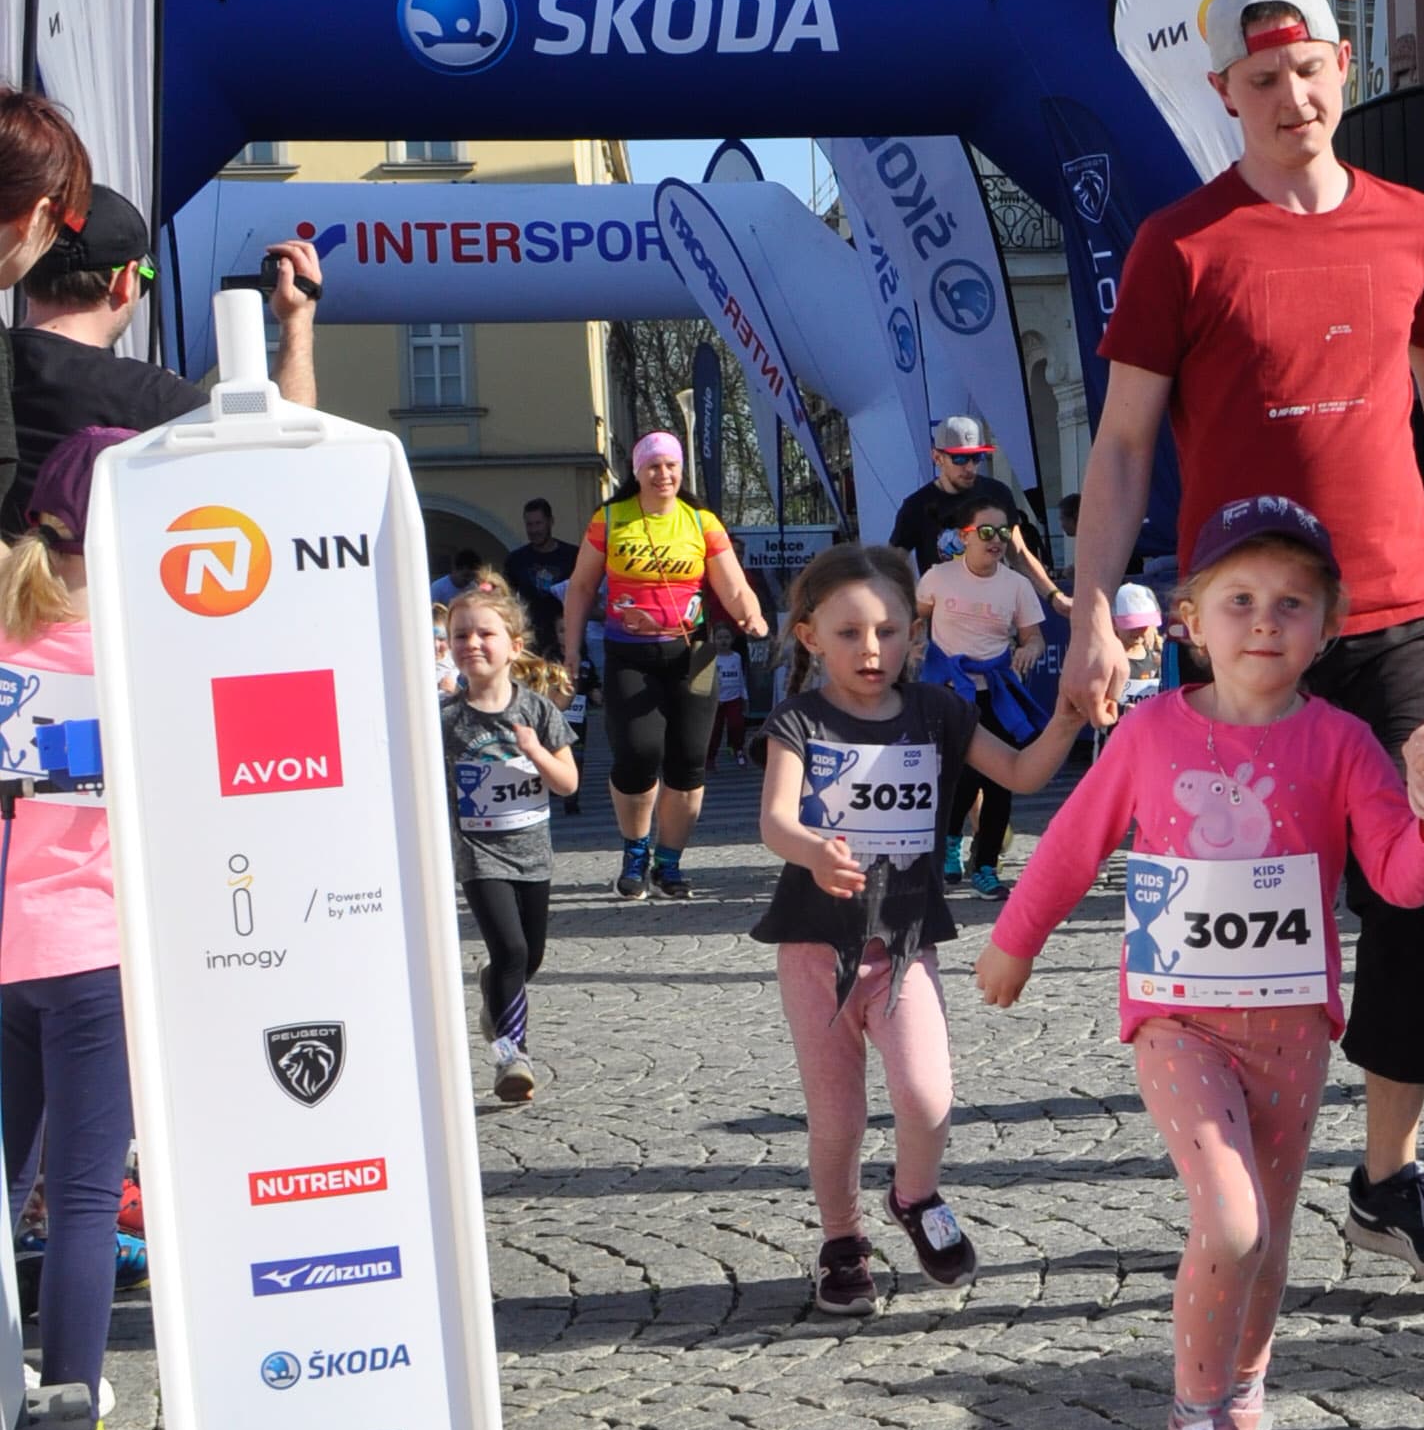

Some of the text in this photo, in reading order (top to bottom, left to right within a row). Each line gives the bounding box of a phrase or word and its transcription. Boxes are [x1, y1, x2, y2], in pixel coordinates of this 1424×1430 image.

[357, 219, 669, 264] INTERSPOR
[702, 386, 713, 459] gorenje
[294, 534, 370, 571] NN
[232, 755, 329, 786] AVON
[811, 754, 837, 766] KIDS
[811, 766, 834, 777] CUP
[491, 777, 543, 803] 3143
[848, 782, 933, 811] 3032
[1134, 873, 1165, 887] KIDS
[1252, 864, 1285, 877] KIDS
[1252, 877, 1282, 889] CUP
[326, 887, 383, 903] Powered
[1134, 889, 1162, 903] CUP
[328, 901, 384, 920] by MVM
[1183, 908, 1311, 950] 3074
[205, 947, 288, 970] innogy
[270, 1027, 339, 1041] PEUGEOT
[256, 1164, 382, 1199] NUTREND
[308, 1344, 411, 1380] ŠKODA
